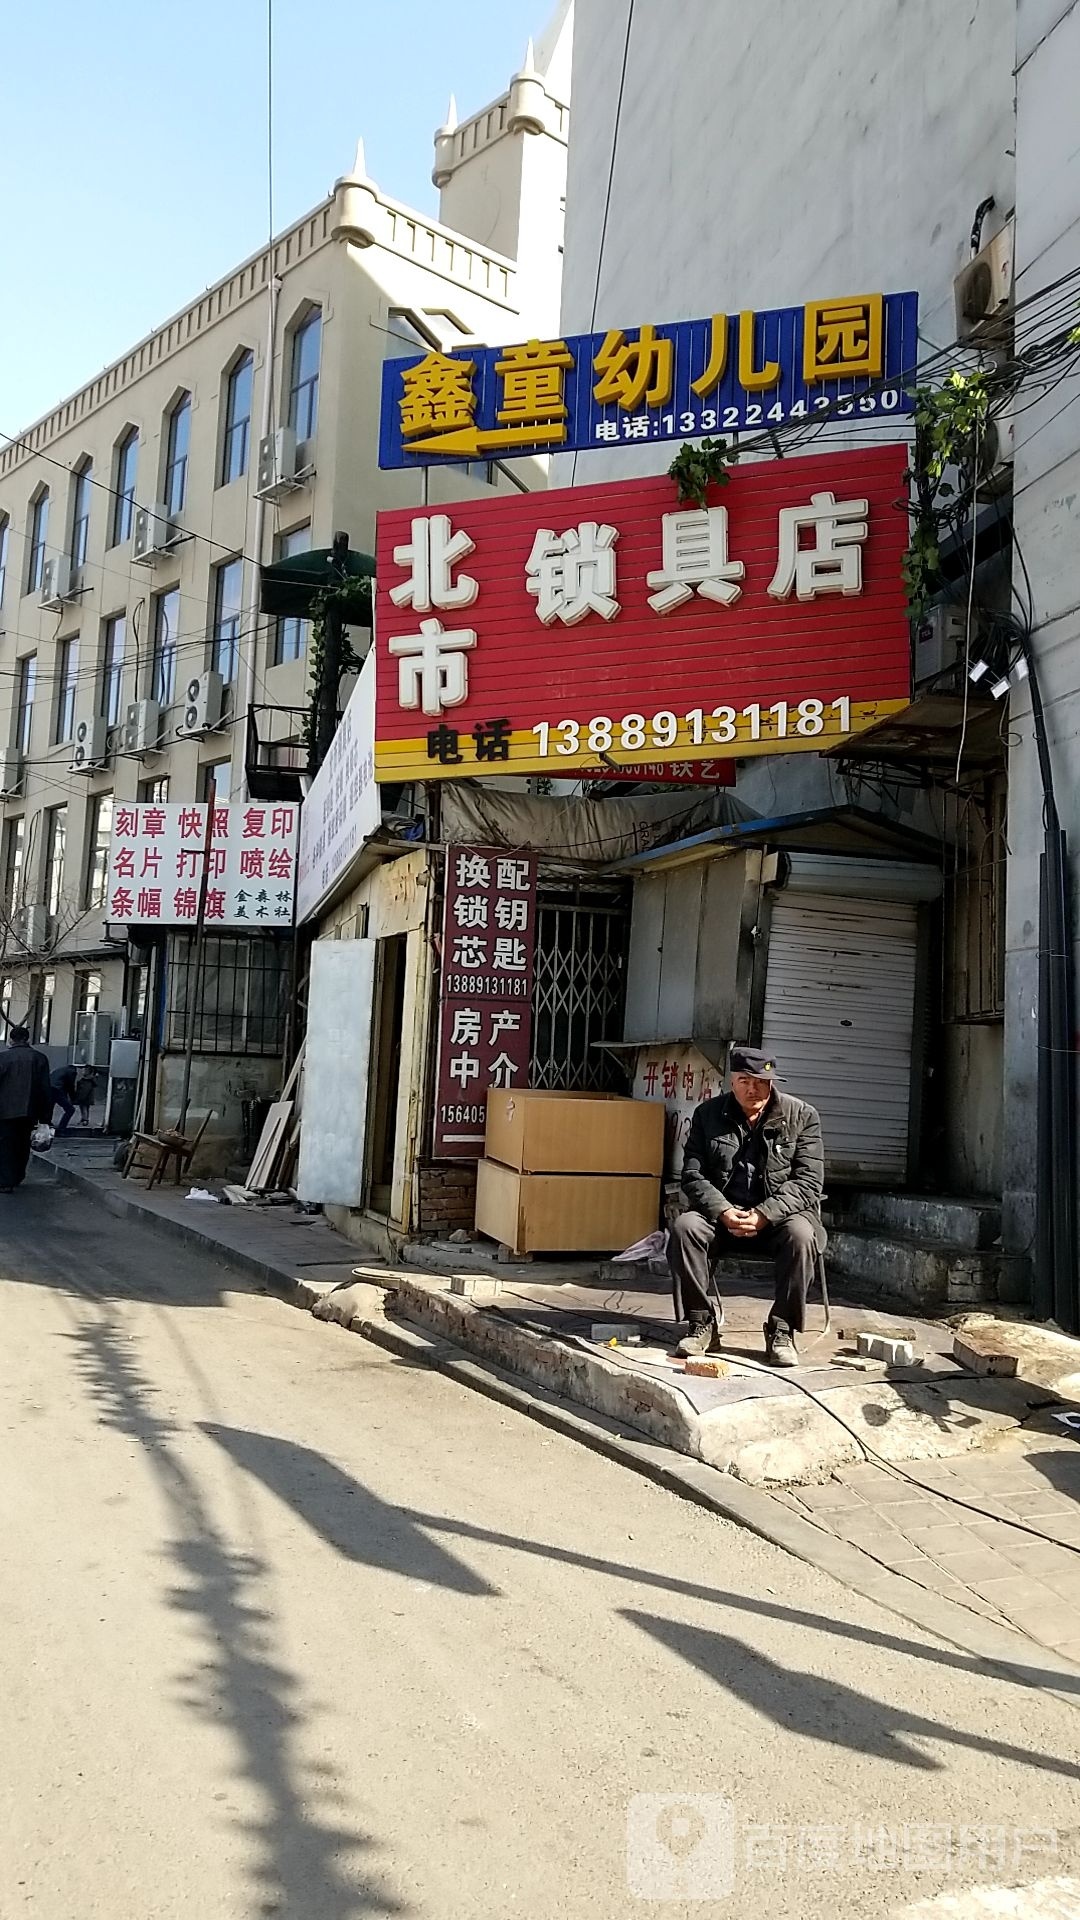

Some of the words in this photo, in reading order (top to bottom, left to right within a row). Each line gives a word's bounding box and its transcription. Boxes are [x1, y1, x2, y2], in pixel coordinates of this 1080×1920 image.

[398, 293, 883, 436] 鑫童幼儿园
[427, 718, 512, 764] 电话
[531, 695, 852, 757] 13889131181
[115, 807, 166, 838] 刻章
[177, 807, 230, 838] 快照
[242, 807, 294, 839] 复印
[113, 847, 163, 878] 名片
[176, 848, 226, 879] 打印
[240, 847, 293, 879] 喷绘
[111, 886, 162, 918] 条幅
[174, 887, 226, 919] 锦旗
[446, 975, 527, 996] 13889131181
